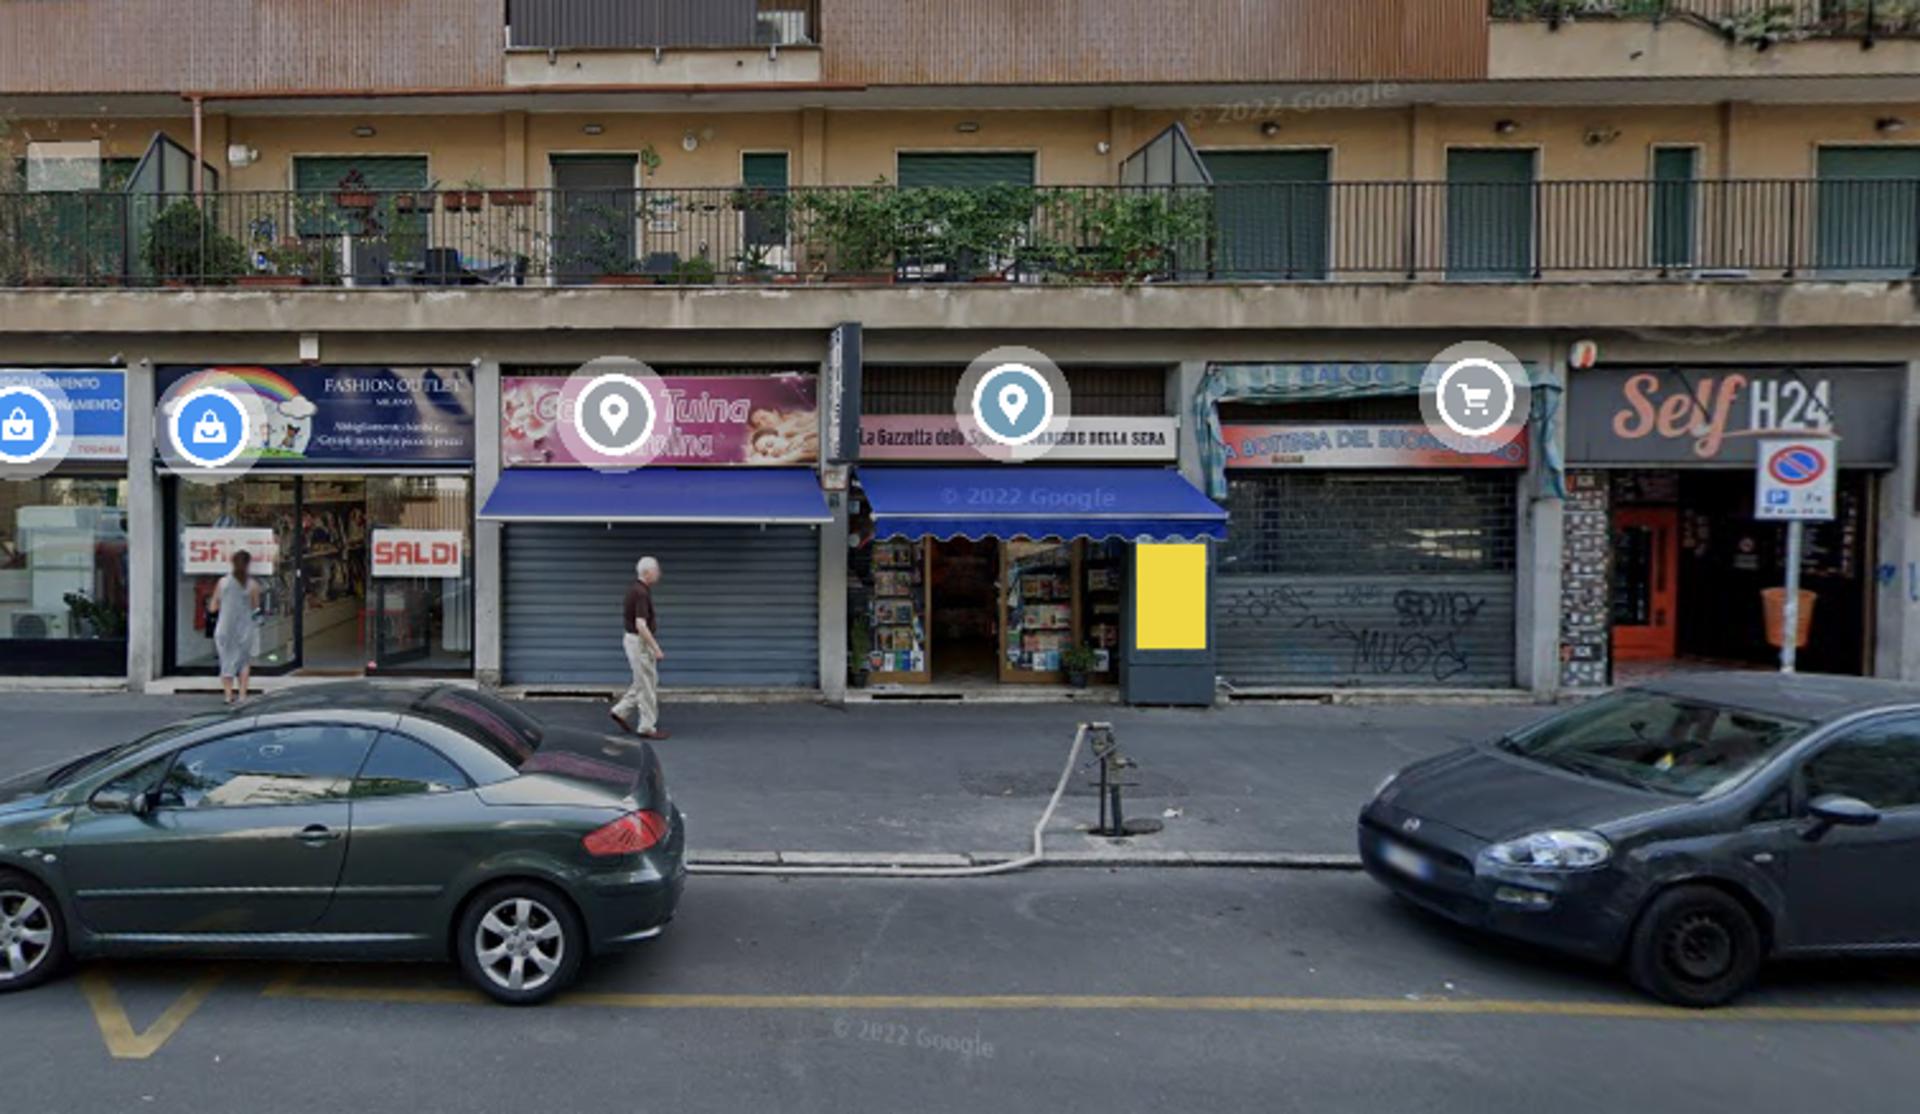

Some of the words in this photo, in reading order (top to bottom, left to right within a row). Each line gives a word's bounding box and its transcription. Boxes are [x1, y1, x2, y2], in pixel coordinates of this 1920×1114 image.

[324, 378, 395, 393] FASHION
[396, 378, 462, 393] OUTLET
[659, 387, 750, 423] Tuina
[1612, 373, 1747, 459] Self
[1751, 379, 1834, 432] H24
[859, 428, 875, 446] La
[877, 428, 932, 446] Gazzetta
[1088, 431, 1128, 446] DELLA
[1131, 431, 1166, 446] SERA
[1335, 429, 1374, 449] DEL
[374, 541, 459, 564] SALDI
